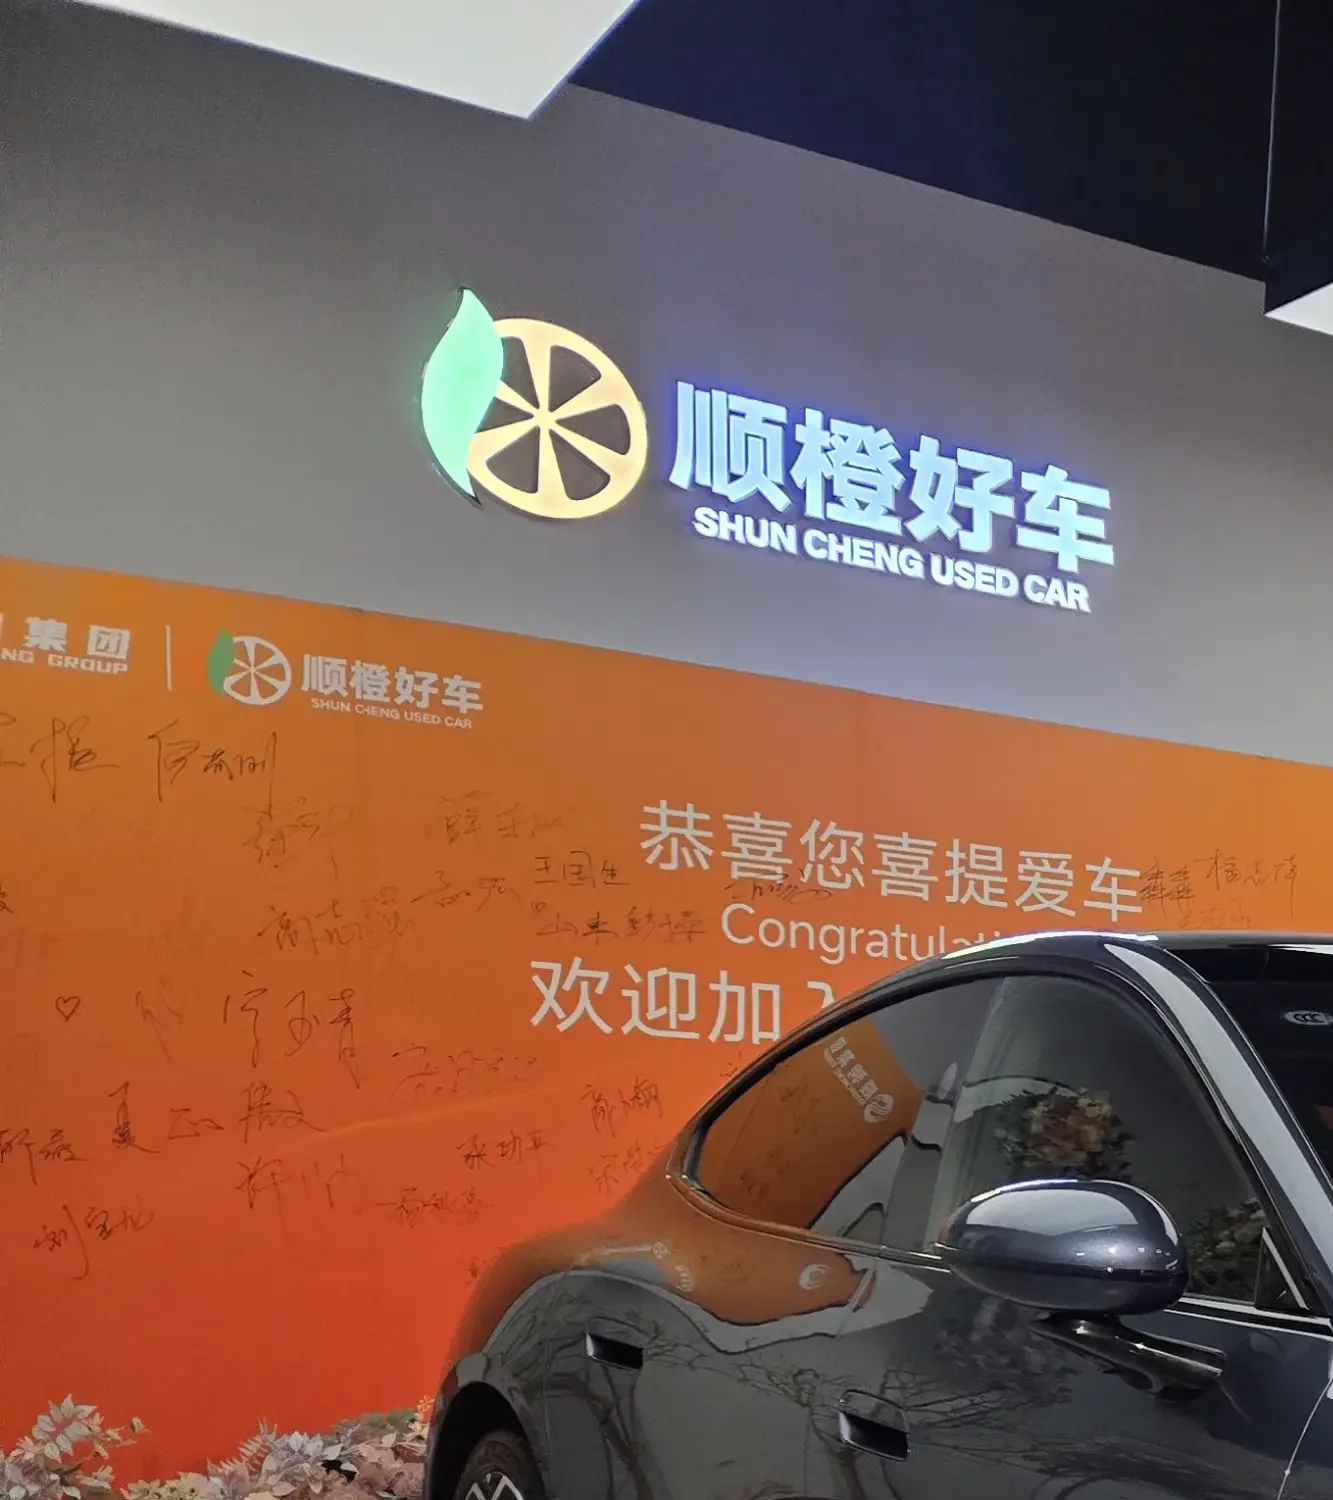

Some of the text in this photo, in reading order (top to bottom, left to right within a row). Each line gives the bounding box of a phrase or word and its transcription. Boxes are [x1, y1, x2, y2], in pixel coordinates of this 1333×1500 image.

[669, 380, 1116, 574] 顺橙好车
[694, 506, 1093, 614] SHUN CHENG USED CAR
[0, 611, 131, 660] 集团
[47, 653, 129, 675] GROUP
[300, 653, 484, 714] 顺橙好车
[310, 697, 473, 729] SHUN CHENG USED CAR
[639, 799, 1143, 923] 恭喜您喜提爱车
[721, 902, 1001, 965] Congratul
